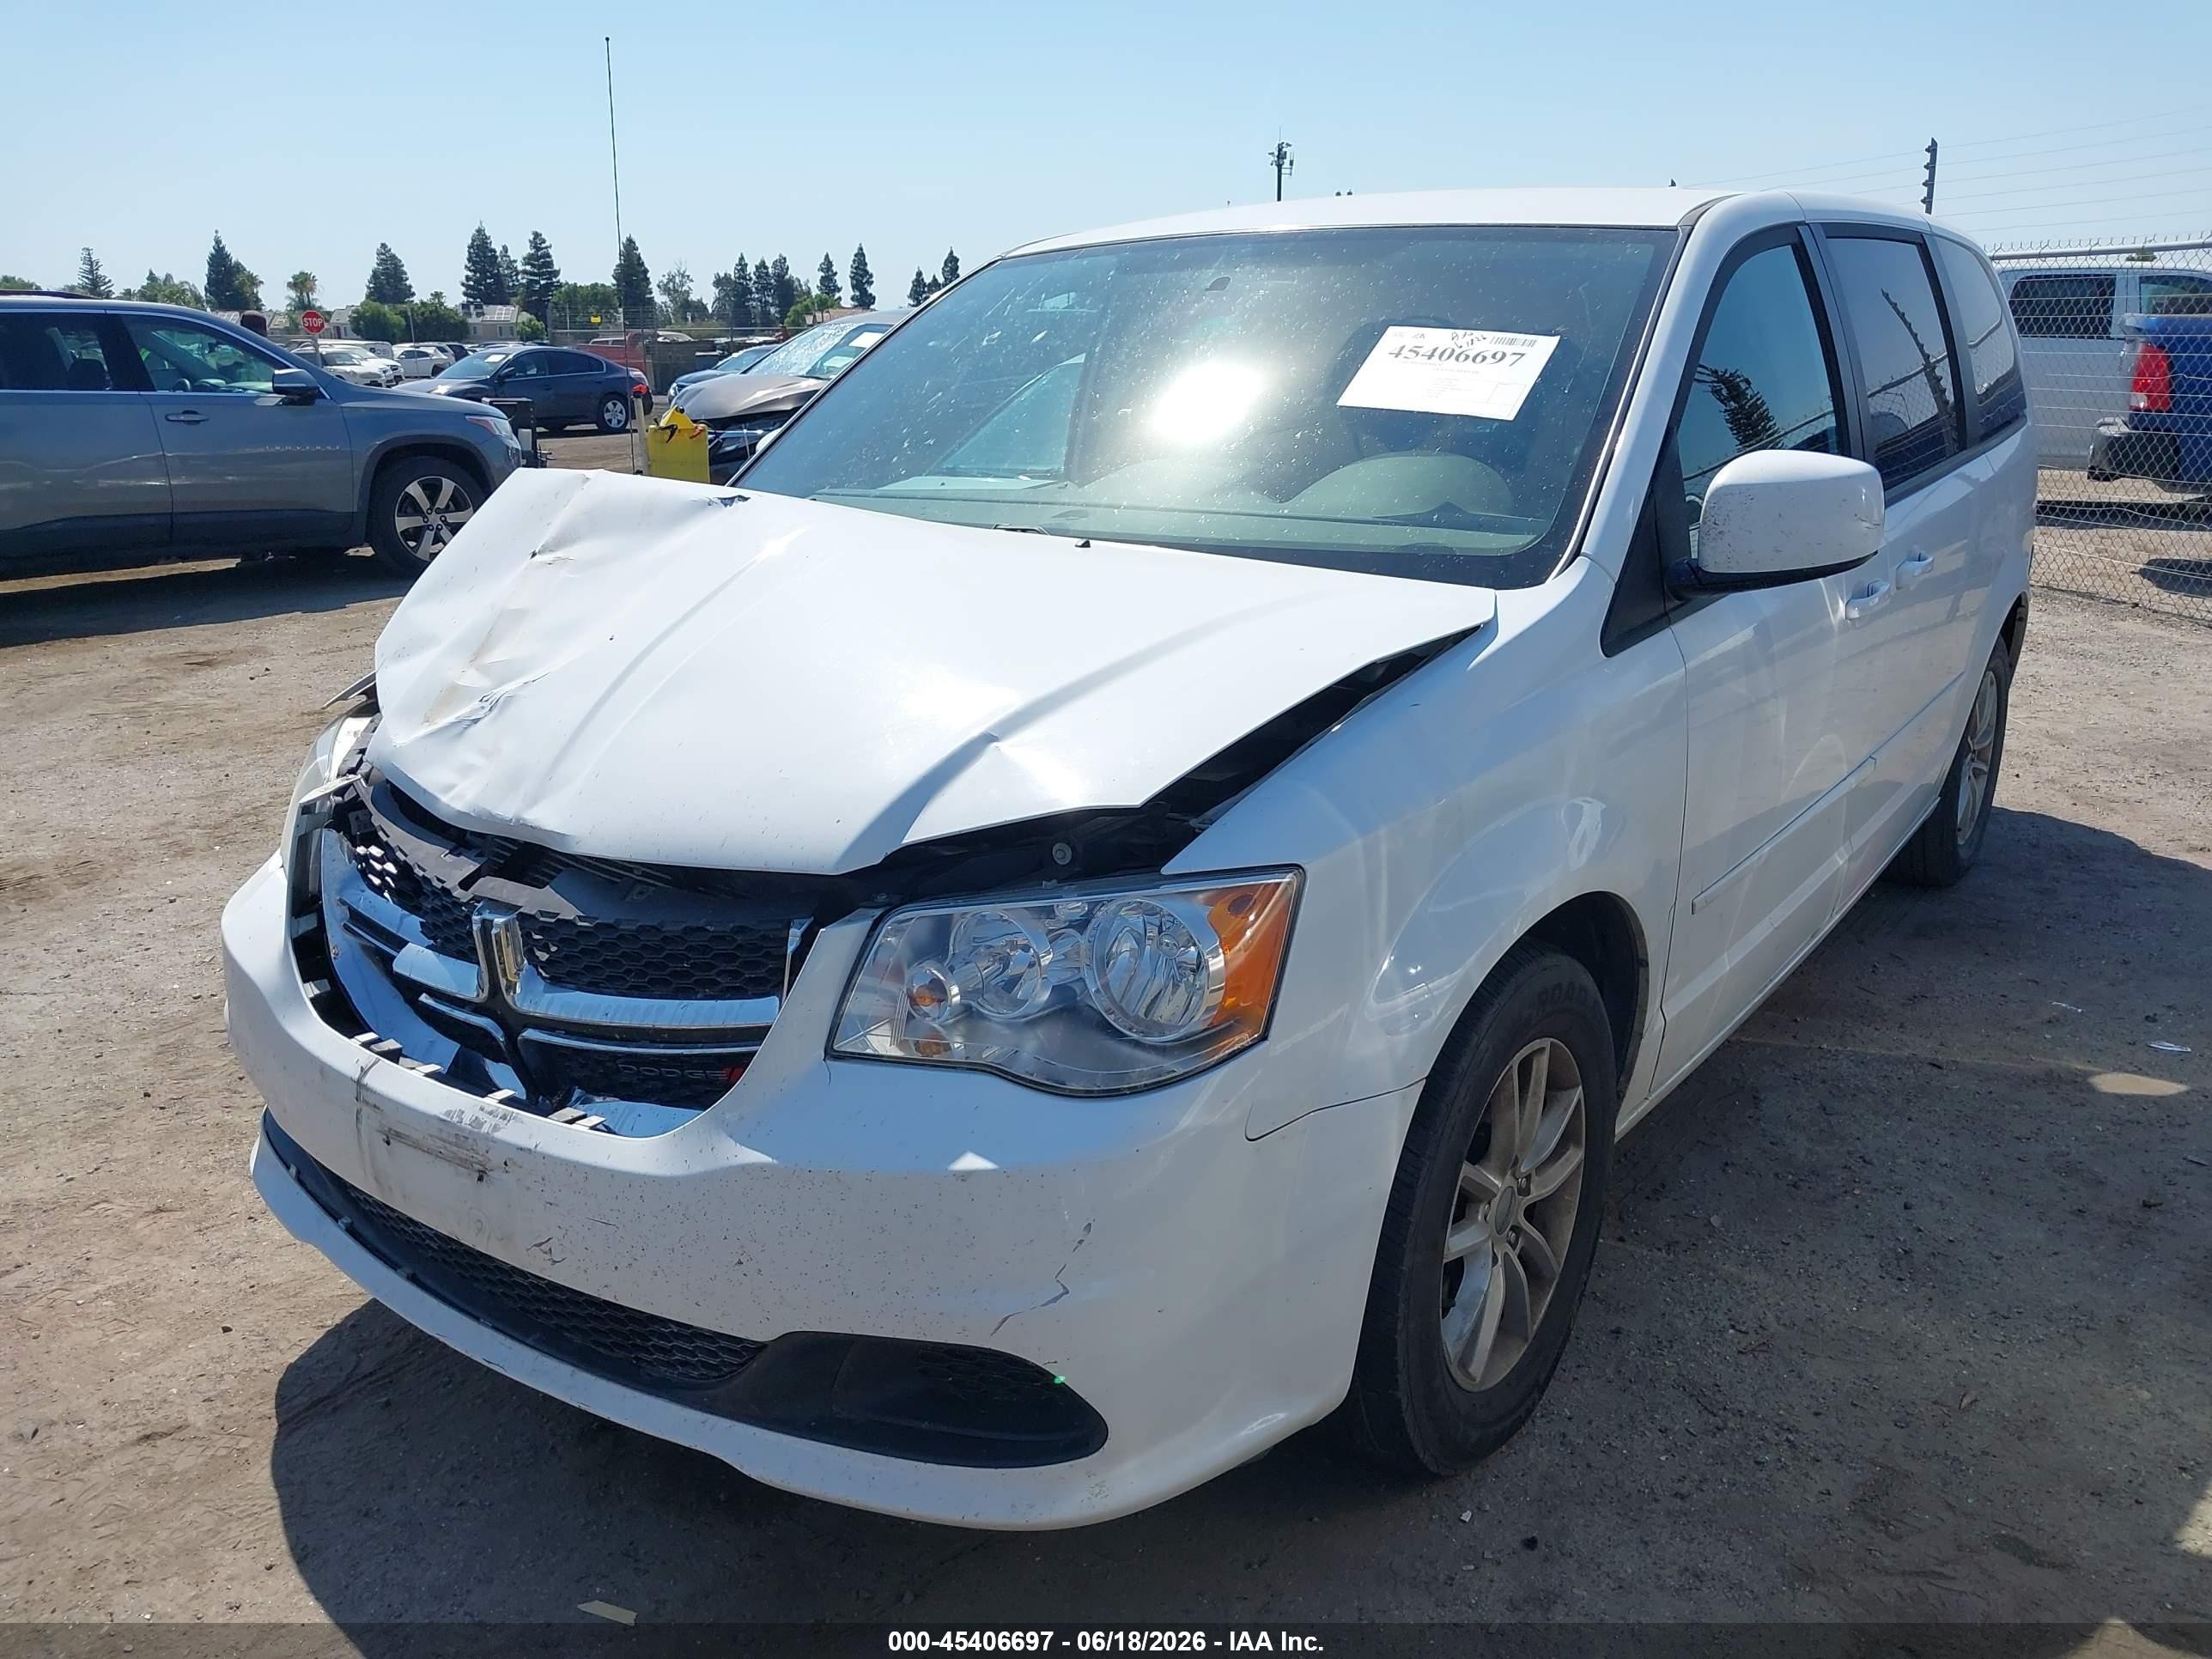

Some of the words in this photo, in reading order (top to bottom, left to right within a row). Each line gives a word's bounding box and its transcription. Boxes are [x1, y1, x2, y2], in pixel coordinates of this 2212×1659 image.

[304, 318, 323, 327] STOP
[1388, 344, 1527, 367] 45406697
[618, 1063, 729, 1079] DODGE
